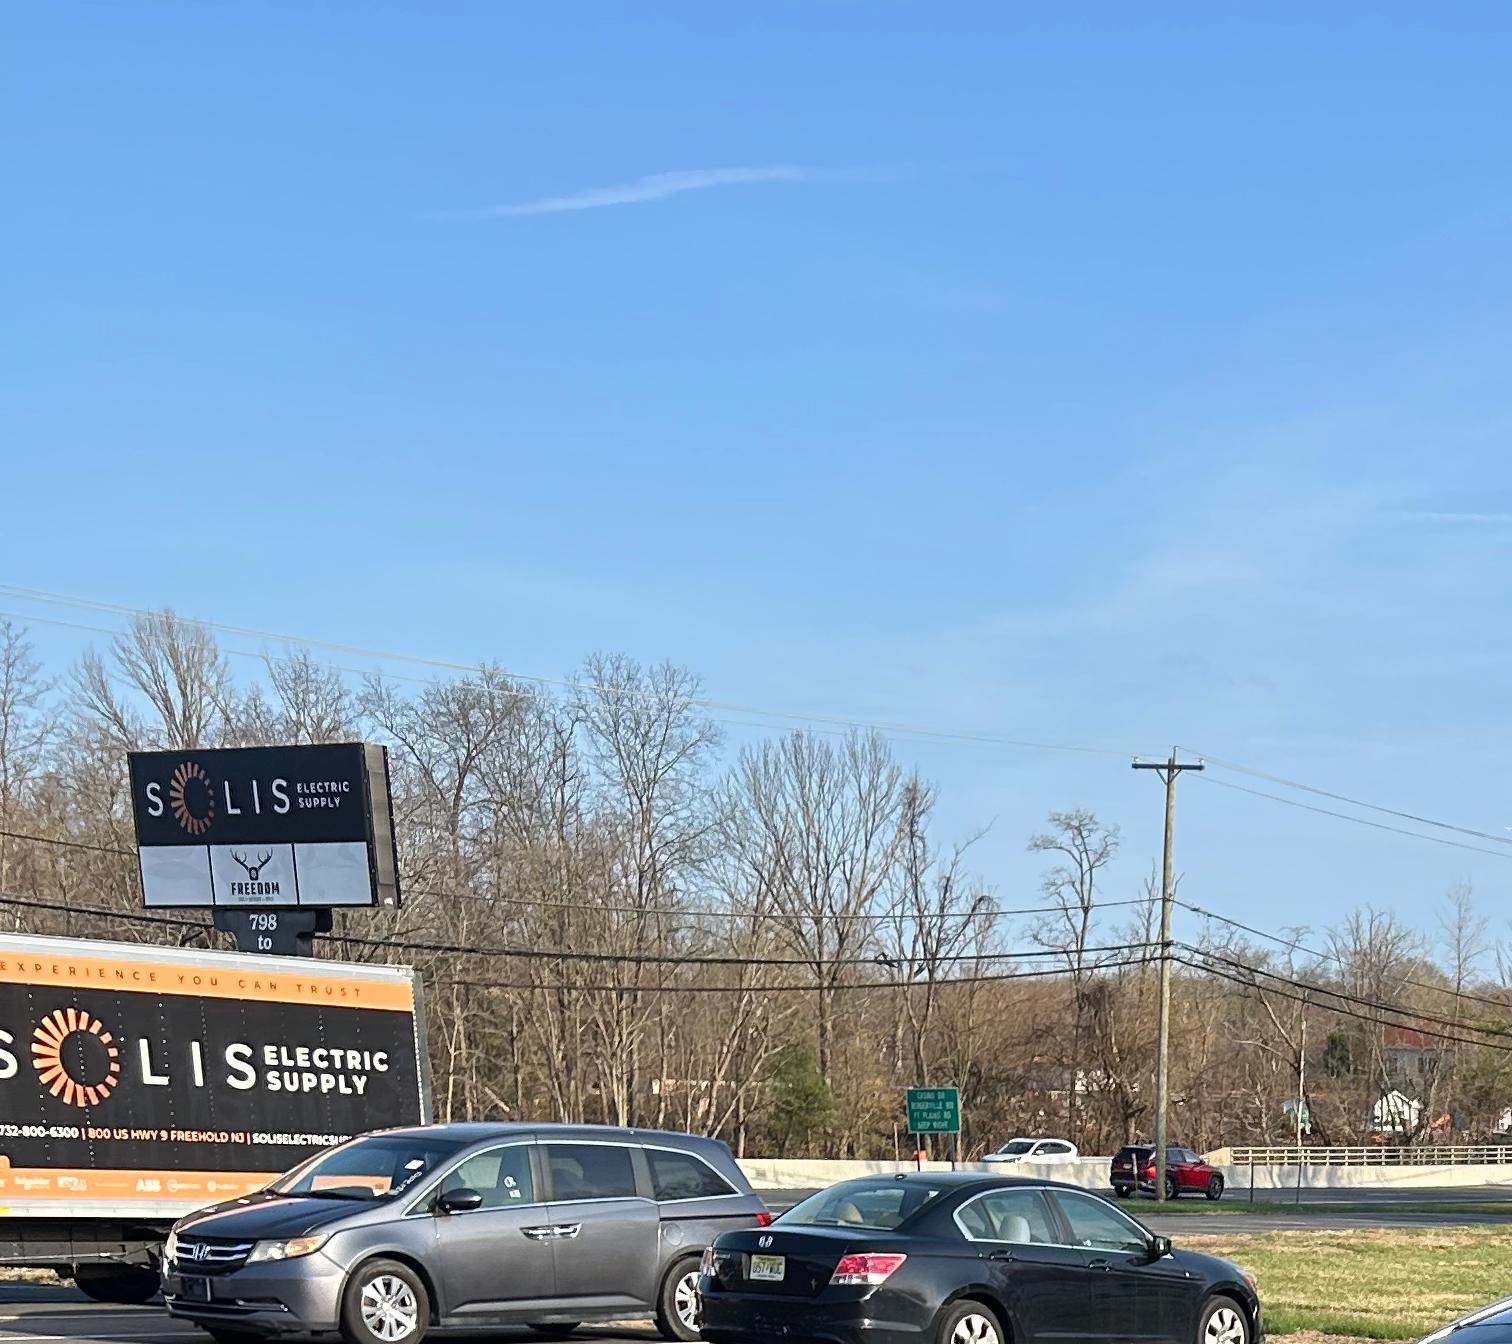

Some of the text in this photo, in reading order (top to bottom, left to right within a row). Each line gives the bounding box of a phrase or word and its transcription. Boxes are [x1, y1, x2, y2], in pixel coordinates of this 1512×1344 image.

[296, 781, 350, 794] ELECTRIC
[298, 796, 342, 809] SUPPLY
[231, 881, 280, 896] FREEDOM
[249, 914, 277, 931] 798
[257, 935, 273, 950] to
[0, 961, 361, 998] EXPERIENCE YOU CAN TRUST
[264, 1044, 390, 1072] ELECTRIC
[266, 1070, 369, 1095] SUPPLY
[88, 1128, 111, 1139] 800
[113, 1128, 129, 1140] US
[130, 1130, 158, 1141] HWY
[160, 1130, 168, 1141] 9
[170, 1130, 229, 1143] FREEHOLD
[231, 1132, 245, 1143] NJ
[136, 1178, 161, 1192] ABB
